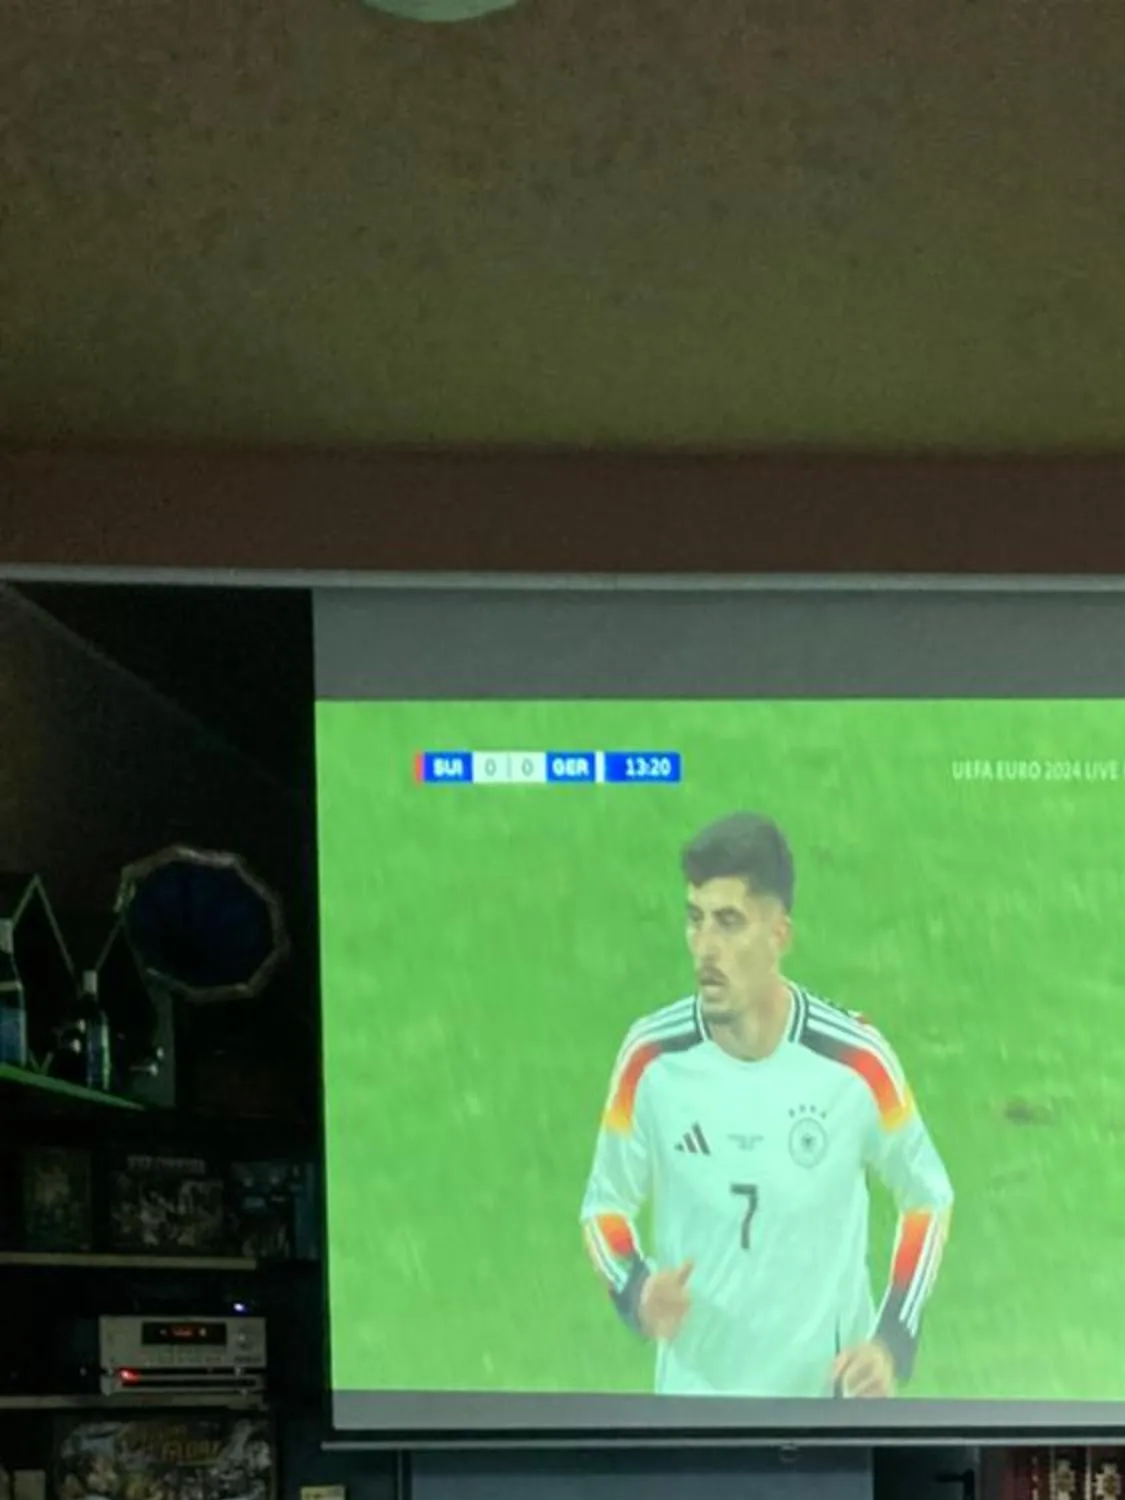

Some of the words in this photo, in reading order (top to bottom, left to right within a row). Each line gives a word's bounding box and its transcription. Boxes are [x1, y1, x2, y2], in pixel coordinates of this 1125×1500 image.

[433, 758, 463, 776] SUI
[485, 760, 496, 777] 0
[521, 760, 533, 777] 0
[552, 758, 588, 776] GER
[625, 757, 672, 776] 13:20
[951, 760, 993, 780] UEFA
[996, 760, 1041, 780] EURO
[1044, 760, 1081, 780] 2024
[1084, 760, 1120, 780] LIVE
[730, 1183, 759, 1250] 7
